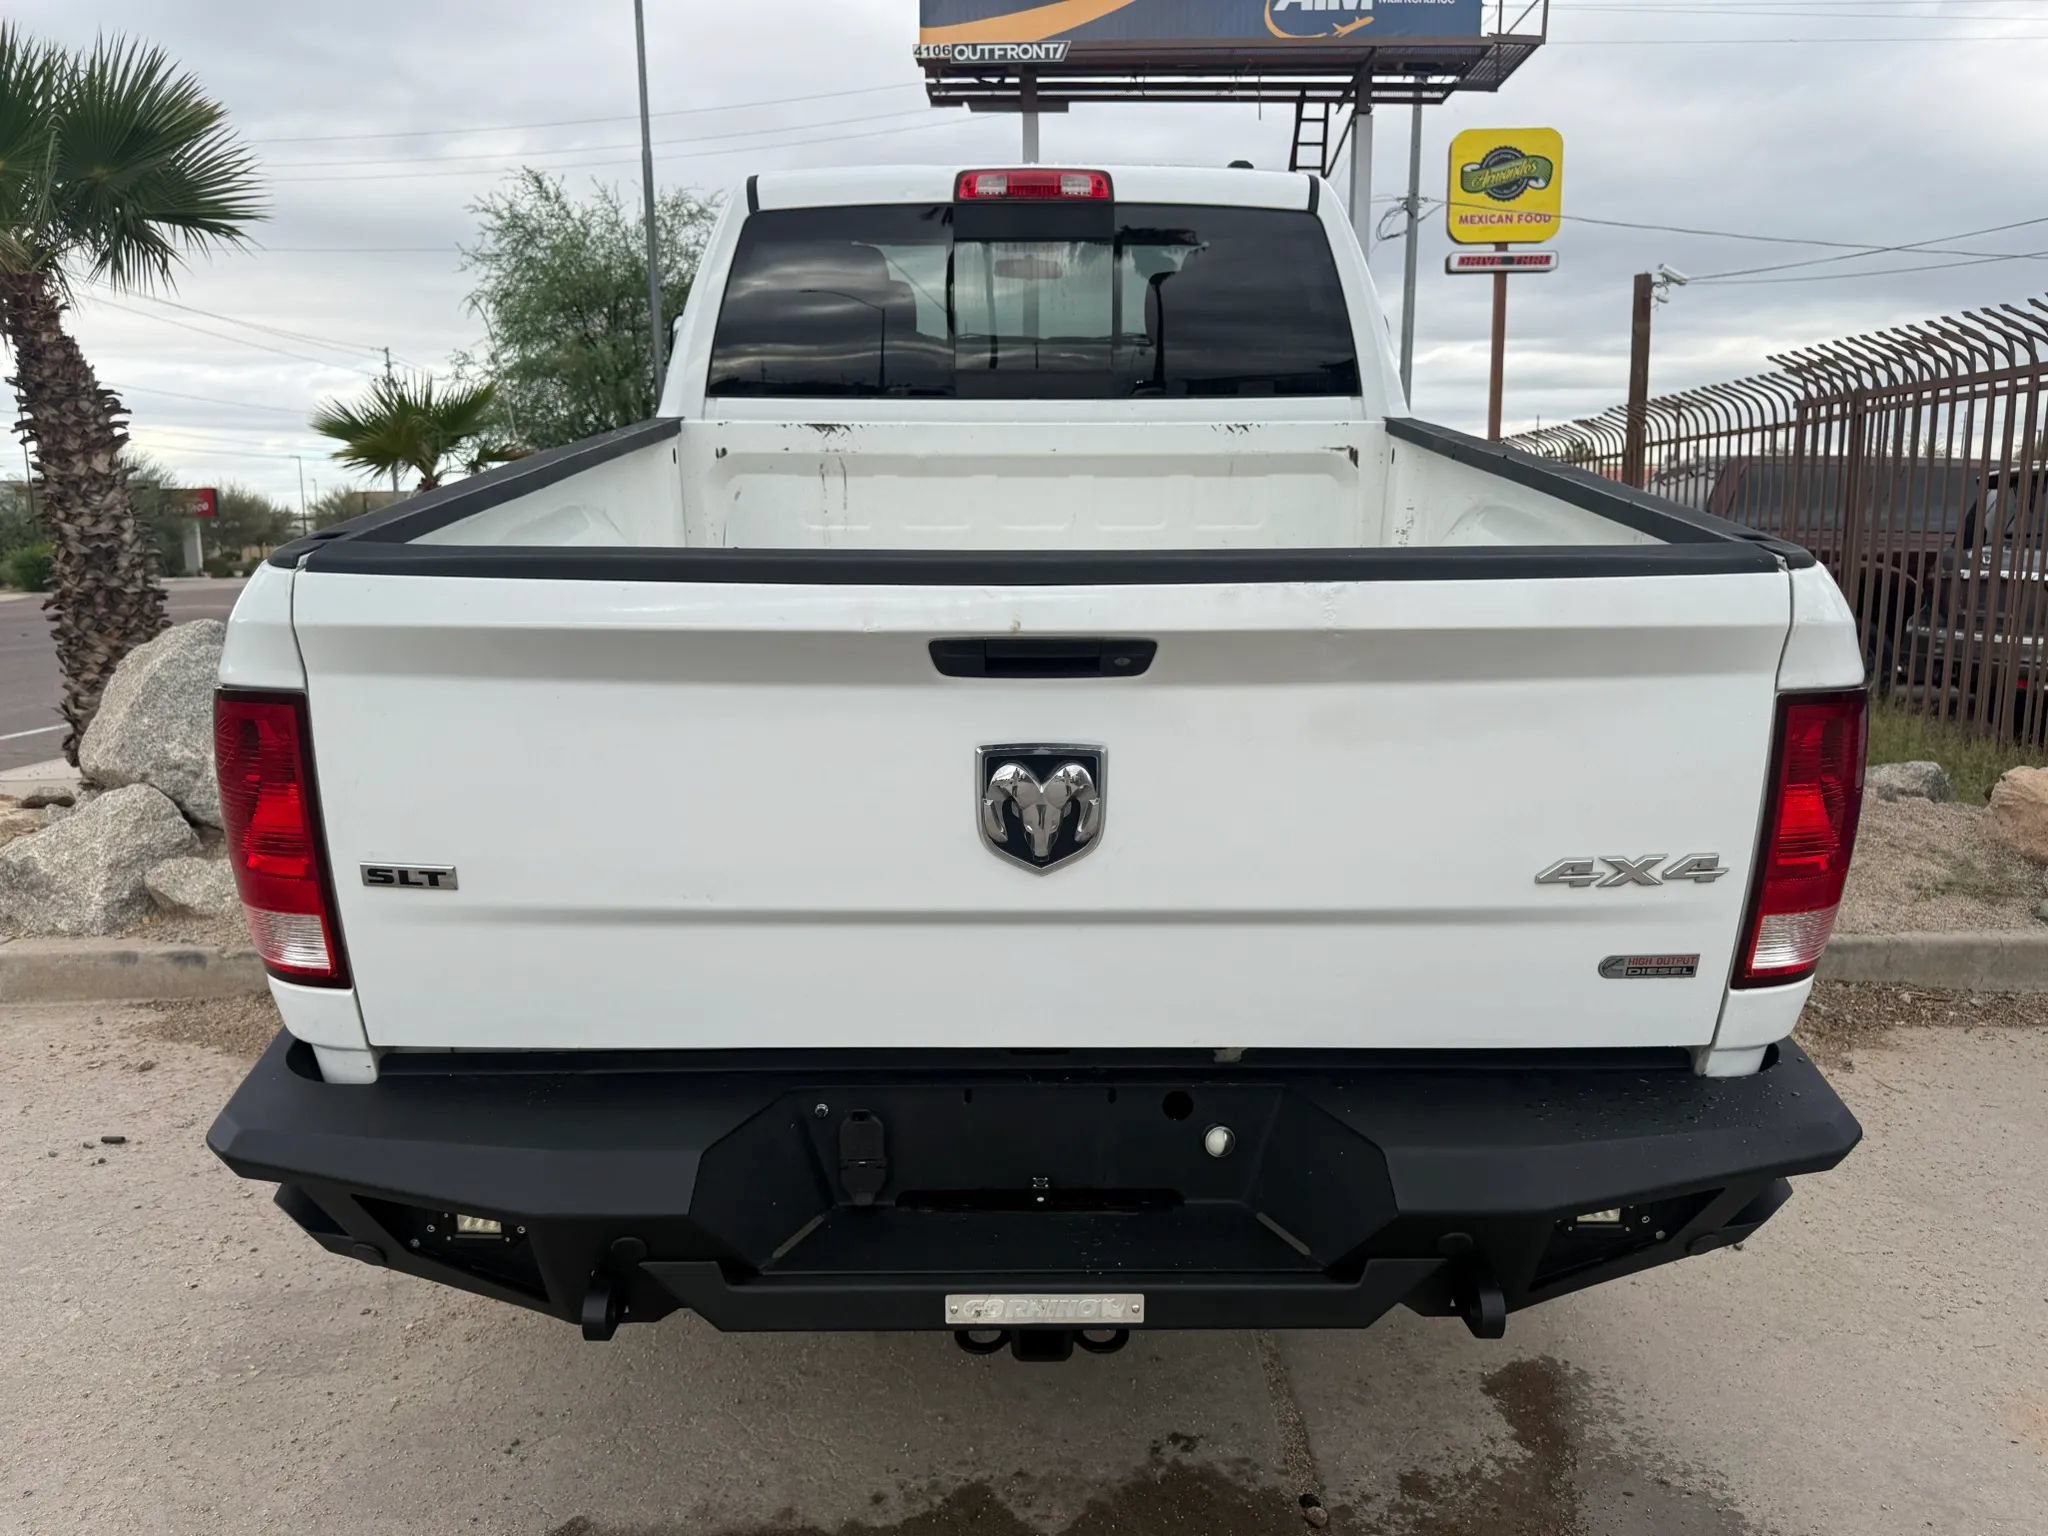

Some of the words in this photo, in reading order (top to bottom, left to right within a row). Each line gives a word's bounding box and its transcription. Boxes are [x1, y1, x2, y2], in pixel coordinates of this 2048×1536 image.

[913, 44, 950, 57] 4106
[1459, 214, 1513, 225] MEXICAN
[1517, 213, 1552, 223] FOOD
[1535, 853, 1730, 888] 4X4
[367, 868, 447, 887] SLT
[1628, 957, 1652, 966] HIGH
[1656, 956, 1697, 966] OUTPUT
[1627, 967, 1693, 976] DIESEL
